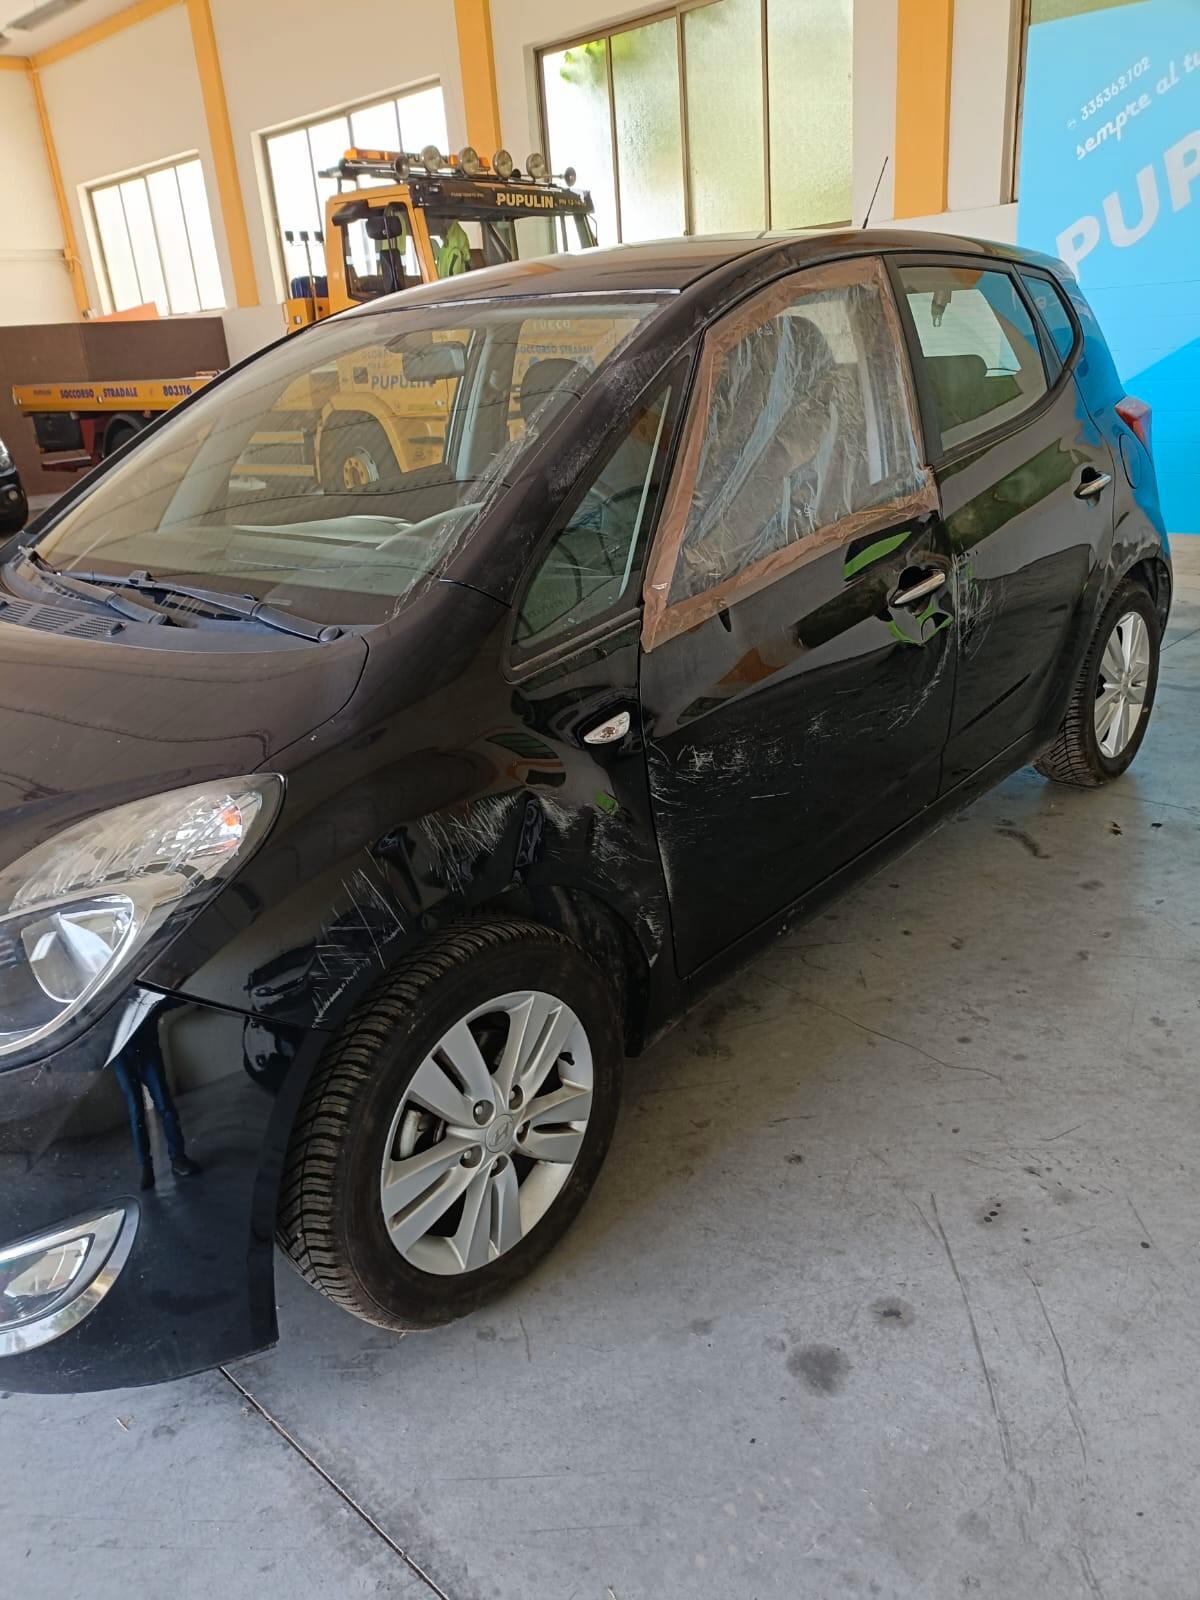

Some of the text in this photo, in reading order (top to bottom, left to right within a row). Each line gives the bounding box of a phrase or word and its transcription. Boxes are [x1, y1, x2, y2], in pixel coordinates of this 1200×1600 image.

[1076, 93, 1152, 160] sempre
[1156, 60, 1179, 95] al
[496, 192, 554, 208] PUPULIN
[60, 388, 95, 400] SOCCORSO
[103, 387, 138, 398] STRADALE
